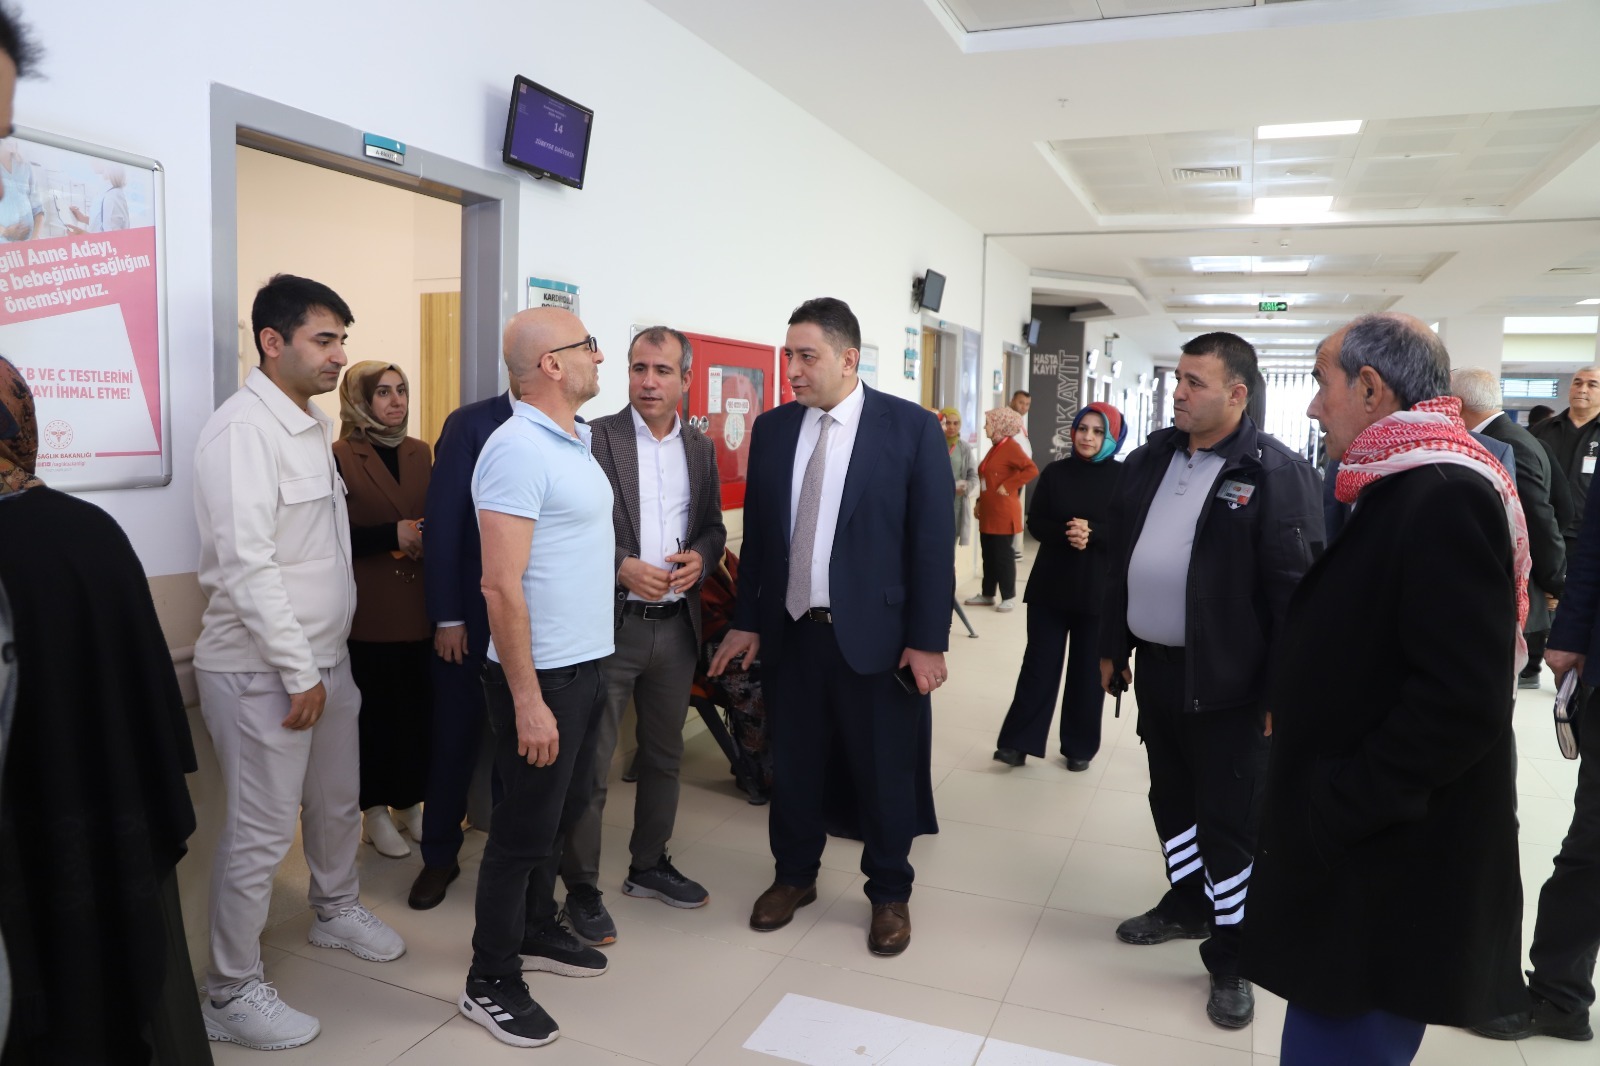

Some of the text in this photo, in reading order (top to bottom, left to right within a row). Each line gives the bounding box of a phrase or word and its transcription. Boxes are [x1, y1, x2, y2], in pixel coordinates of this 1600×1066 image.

[554, 122, 564, 135] 14
[28, 248, 69, 266] Anne
[71, 240, 117, 259] Adayı,
[10, 263, 91, 291] bebeğinin
[92, 254, 151, 277] sağlığını
[5, 283, 109, 314] önemsiyoruz.
[1033, 353, 1059, 365] HASTA
[26, 367, 134, 384] B VE C TESTLERİNİ
[1032, 364, 1058, 375] KAYIT
[28, 383, 131, 400] AYI İHMAL ETME!
